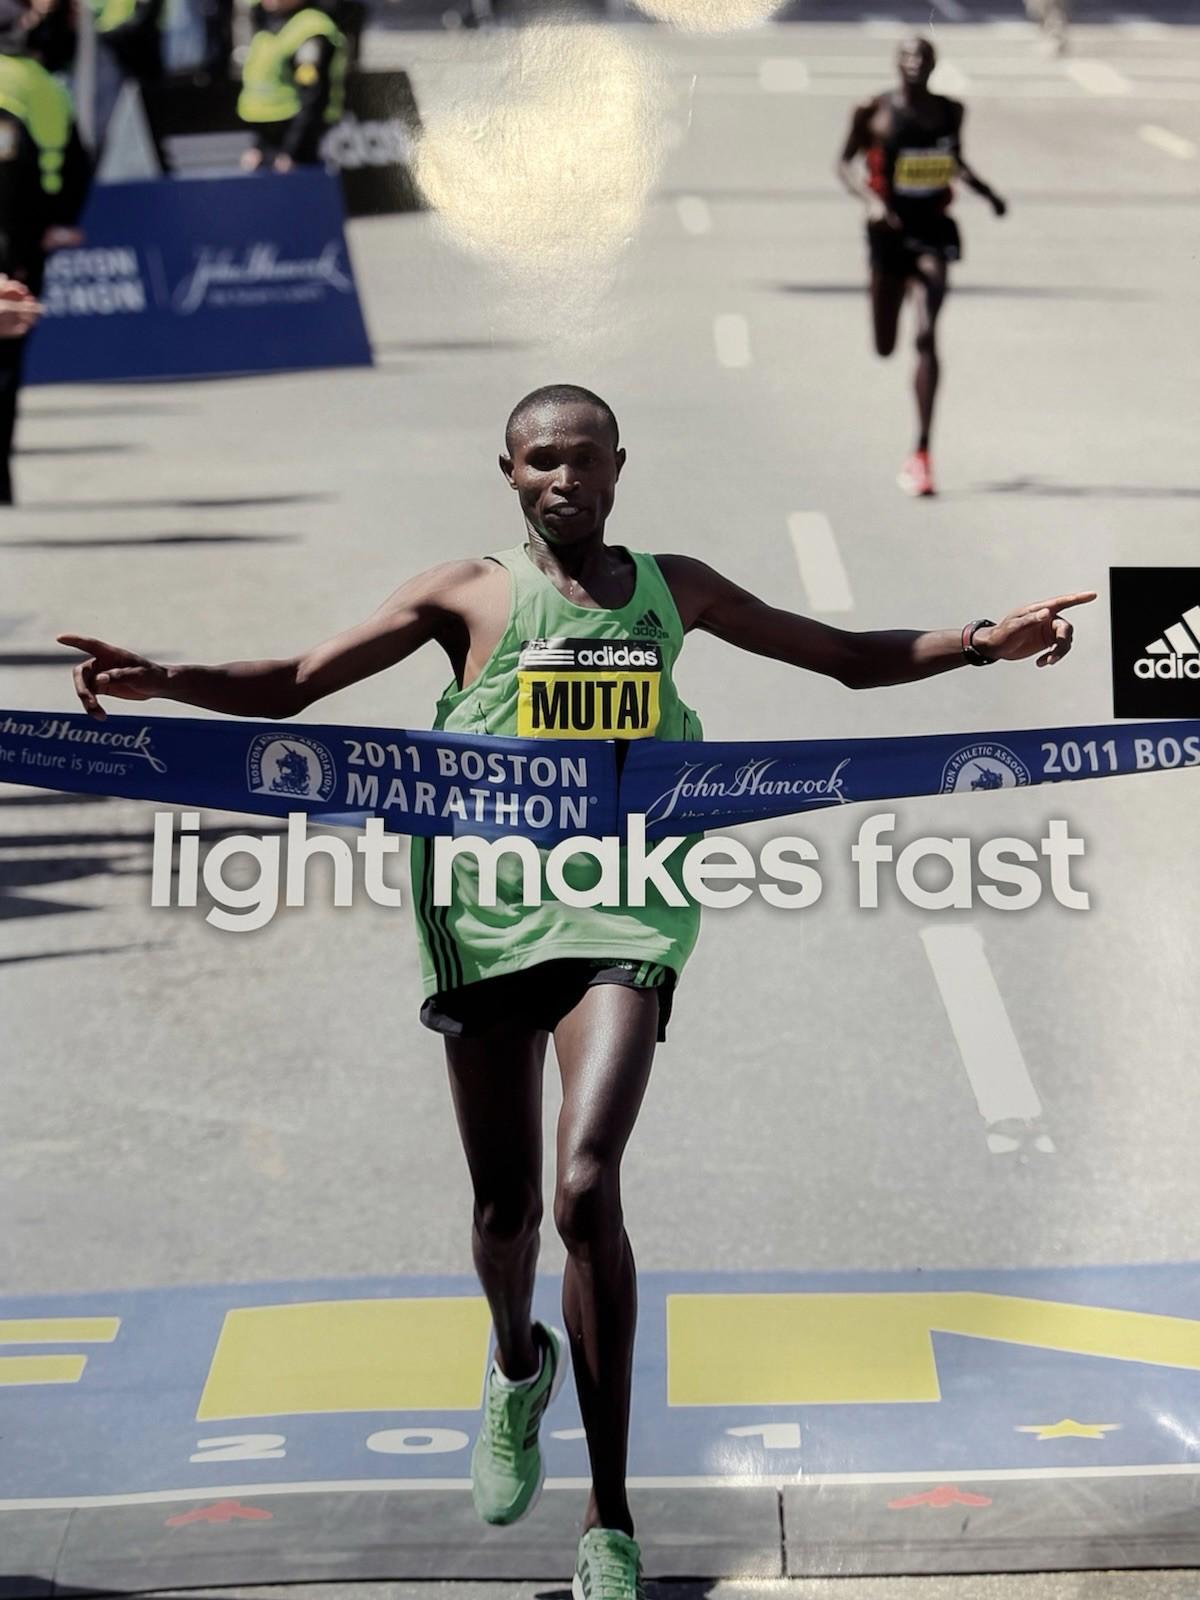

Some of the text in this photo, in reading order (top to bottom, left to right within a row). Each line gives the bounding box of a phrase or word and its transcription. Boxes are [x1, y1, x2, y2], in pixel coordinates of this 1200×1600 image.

[577, 646, 658, 667] adidas
[532, 681, 650, 731] MUTAI
[21, 747, 67, 769] future
[71, 755, 83, 771] is
[86, 759, 127, 776] yours
[33, 719, 168, 774] Hancock
[343, 740, 588, 788] 2011 BOSTON
[951, 746, 994, 770] ATHLETIC
[1040, 736, 1200, 773] 2011 BOS
[645, 757, 854, 828] John Hancock
[151, 812, 1090, 932] light makes fast
